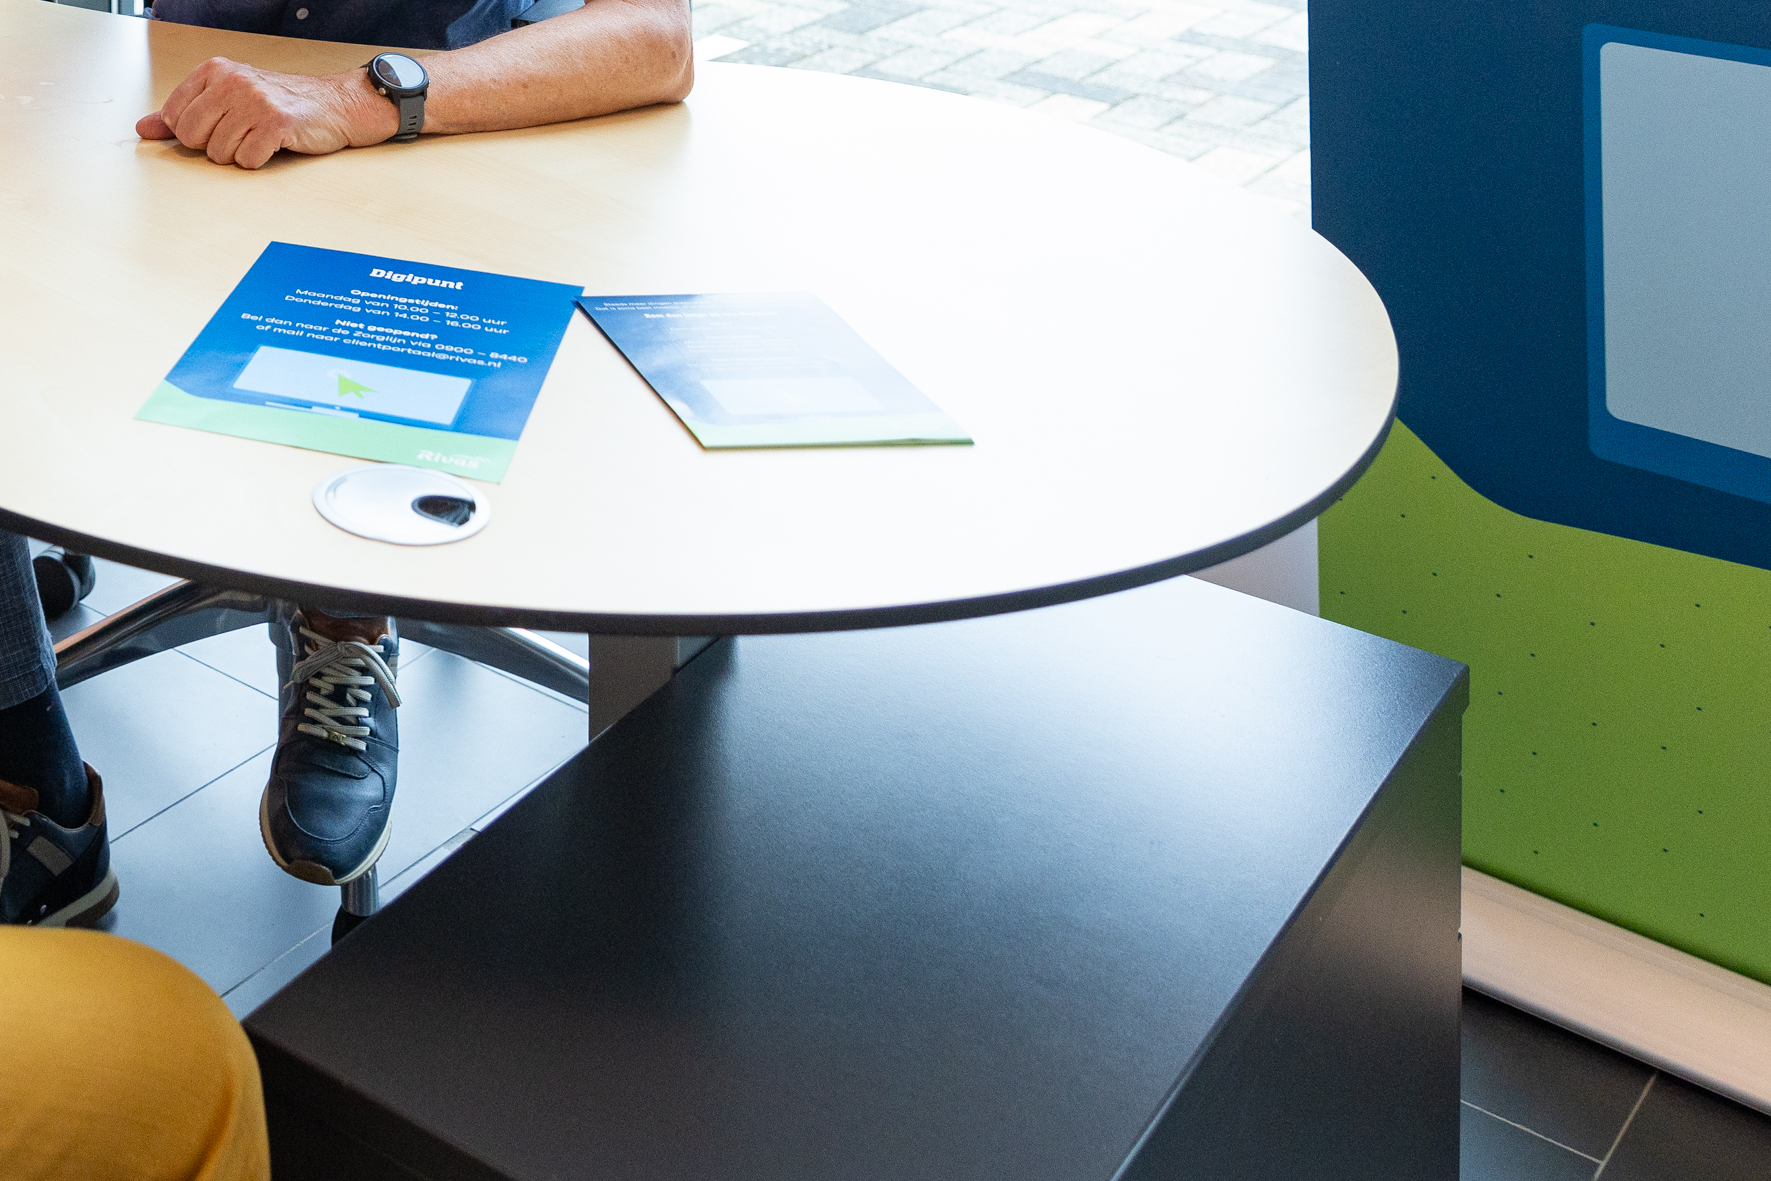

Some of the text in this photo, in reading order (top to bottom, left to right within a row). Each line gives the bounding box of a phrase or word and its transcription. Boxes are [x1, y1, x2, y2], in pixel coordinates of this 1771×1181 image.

[369, 268, 464, 290] Digipunt
[296, 289, 361, 304] Maandag
[364, 299, 389, 308] van
[393, 304, 429, 314] 10.00
[445, 311, 480, 322] 12.00
[482, 317, 507, 326] uur
[350, 289, 459, 310] Openingstijden:
[284, 295, 361, 313] Donderdag
[365, 308, 390, 316] van
[394, 312, 429, 322] 14.00
[445, 320, 481, 330] 16.00
[484, 326, 509, 334] uur
[241, 313, 263, 321] Bel
[265, 317, 292, 326] dan
[295, 321, 329, 332] naar
[331, 327, 350, 335] de
[353, 330, 406, 344] Zorglijn
[410, 340, 431, 348] via
[434, 343, 474, 355] 0900
[489, 351, 528, 364] 8440
[335, 319, 438, 340] Niet geopend?
[273, 327, 304, 337] mail
[306, 332, 340, 342] naar
[342, 338, 502, 368] clientportaal@rivas.nl
[416, 449, 479, 469] Rivas
